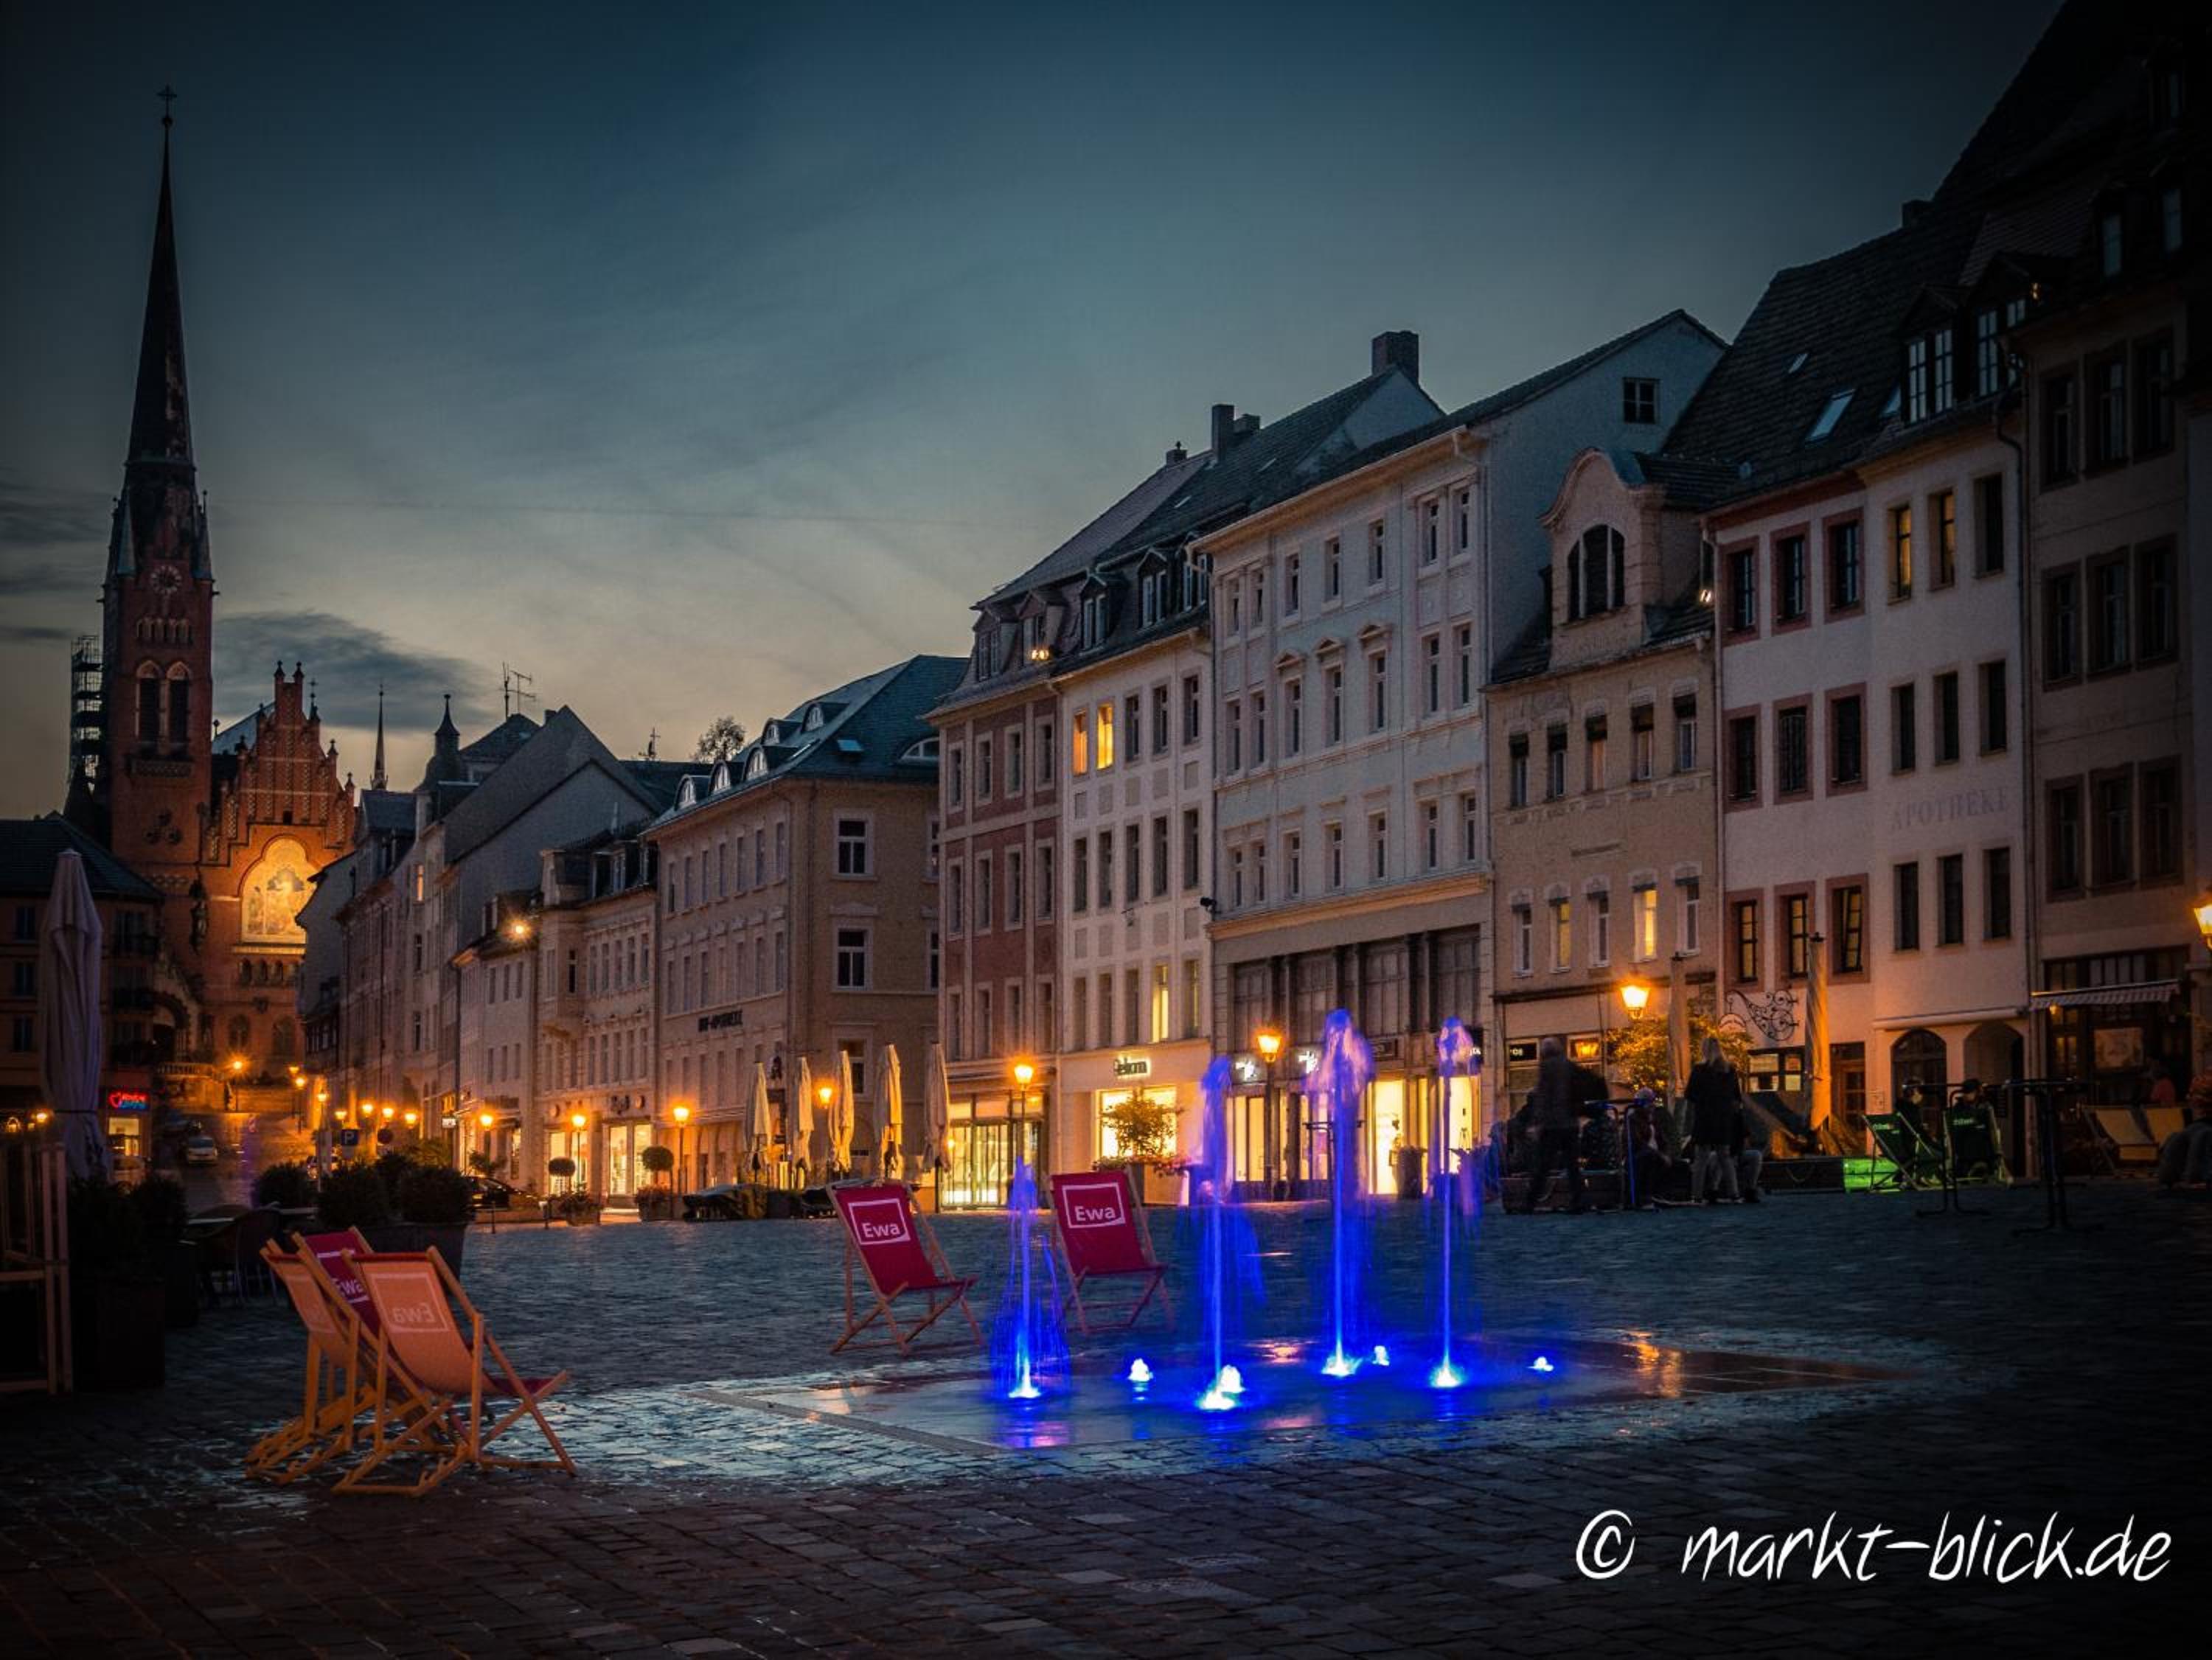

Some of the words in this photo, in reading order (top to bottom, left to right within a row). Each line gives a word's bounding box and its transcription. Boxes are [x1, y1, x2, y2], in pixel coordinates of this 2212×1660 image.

[1890, 787, 2008, 831] APOTHEKE
[344, 1132, 355, 1144] P
[1074, 1205, 1116, 1221] Ewa
[861, 1222, 900, 1238] Ewa
